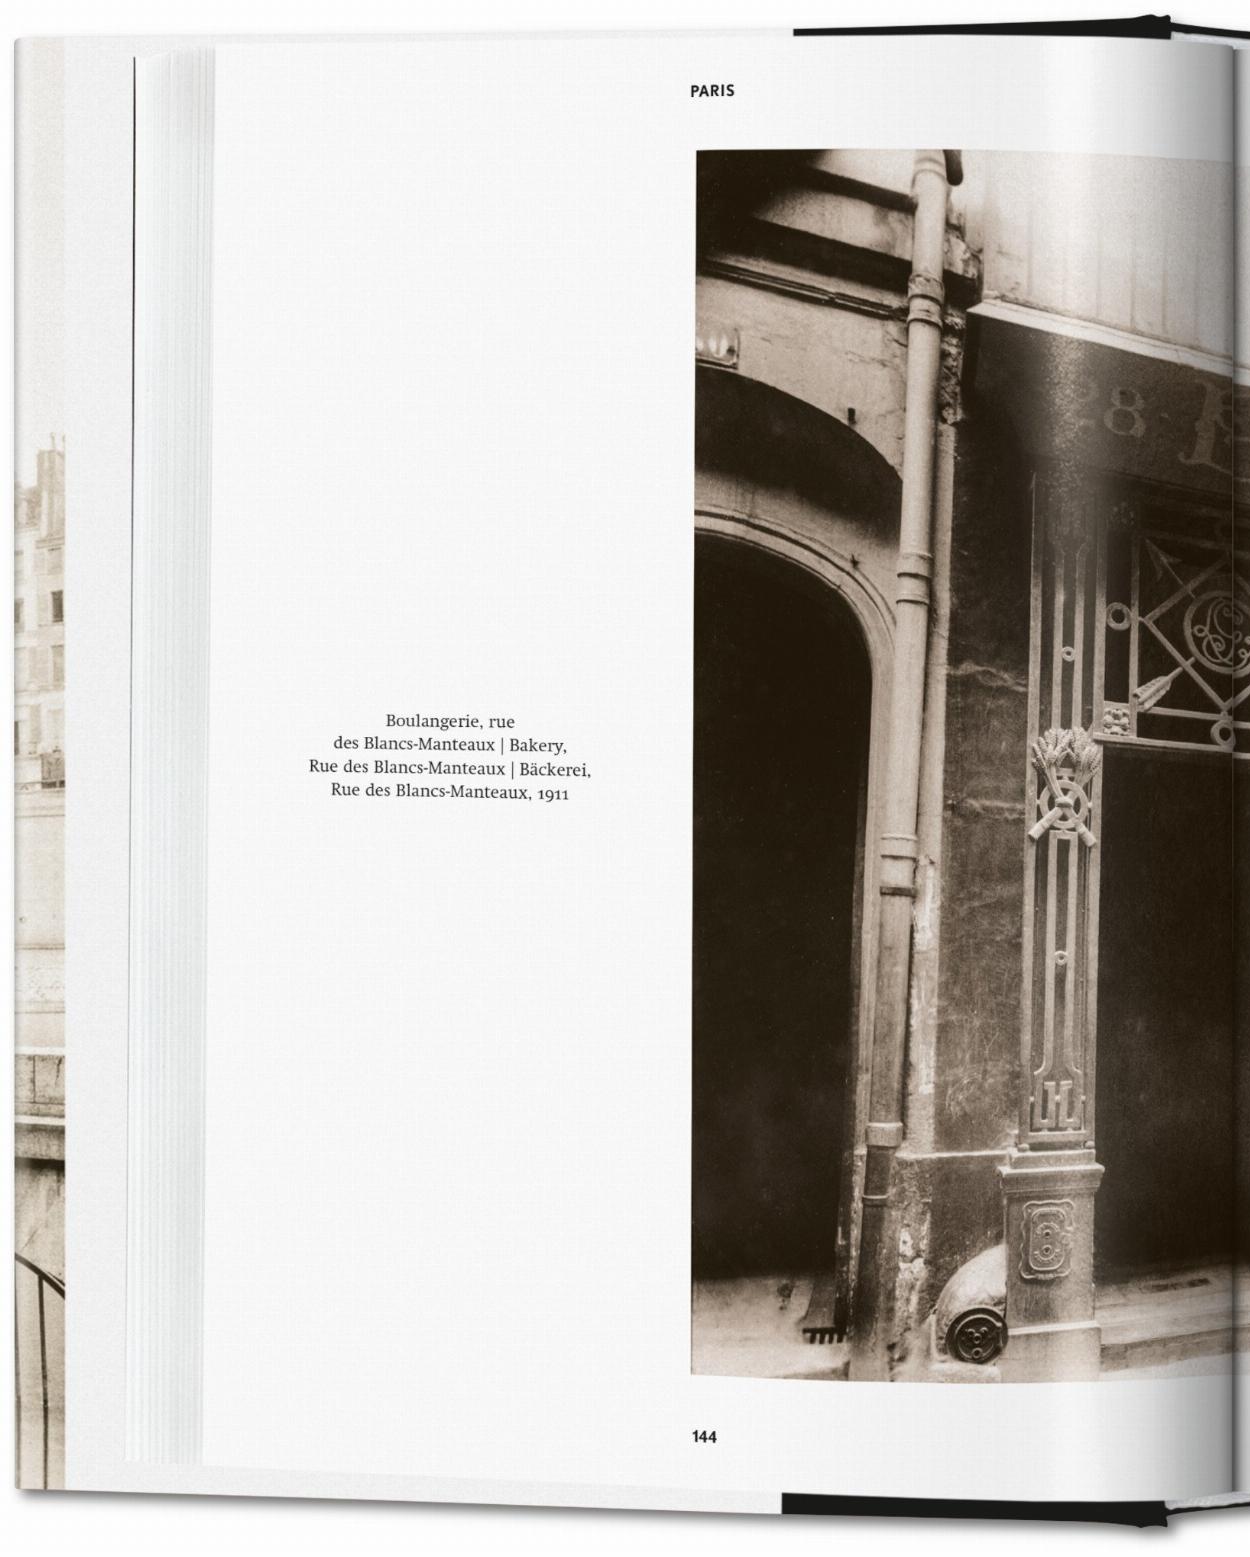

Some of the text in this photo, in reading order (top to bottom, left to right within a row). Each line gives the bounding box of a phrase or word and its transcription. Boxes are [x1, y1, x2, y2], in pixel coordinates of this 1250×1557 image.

[690, 83, 735, 98] PARIS
[385, 713, 516, 731] Boulangerie, rue
[333, 735, 359, 750] des
[363, 735, 496, 752] Blancs-Manteaux
[509, 737, 567, 756] Bakery,
[308, 758, 339, 773] Rue
[343, 758, 369, 774] des
[373, 759, 506, 776] Blancs-Manteaux
[519, 761, 592, 779] Bäckerei,
[330, 781, 569, 803] Rue des Blancs-Manteaux, 1911
[692, 1429, 718, 1444] 144
